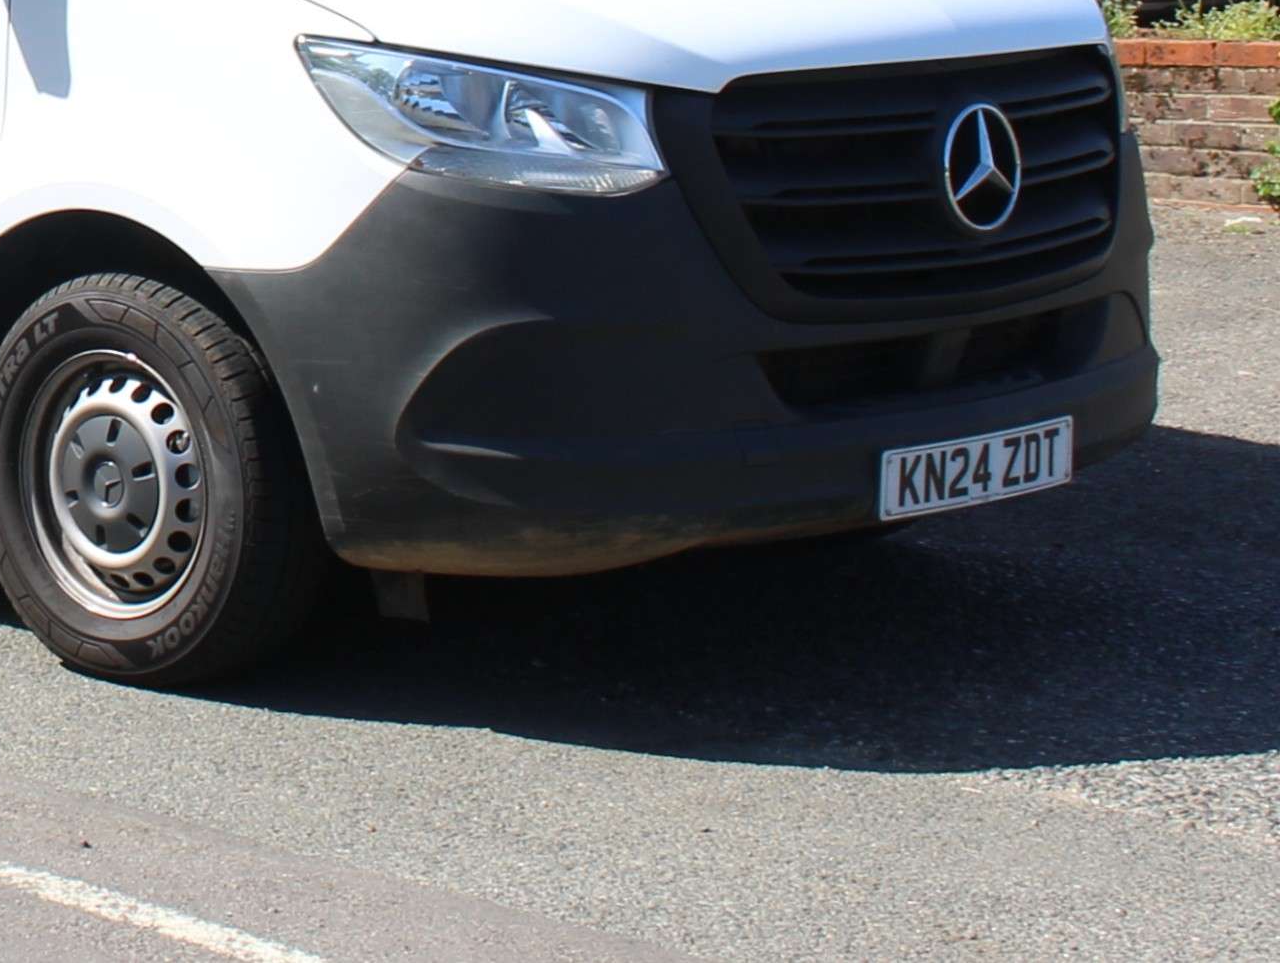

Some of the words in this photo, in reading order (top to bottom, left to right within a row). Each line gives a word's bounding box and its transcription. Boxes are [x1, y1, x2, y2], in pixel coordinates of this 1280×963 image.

[32, 311, 60, 344] LT
[898, 443, 992, 507] KN24
[1001, 427, 1061, 488] ZDT
